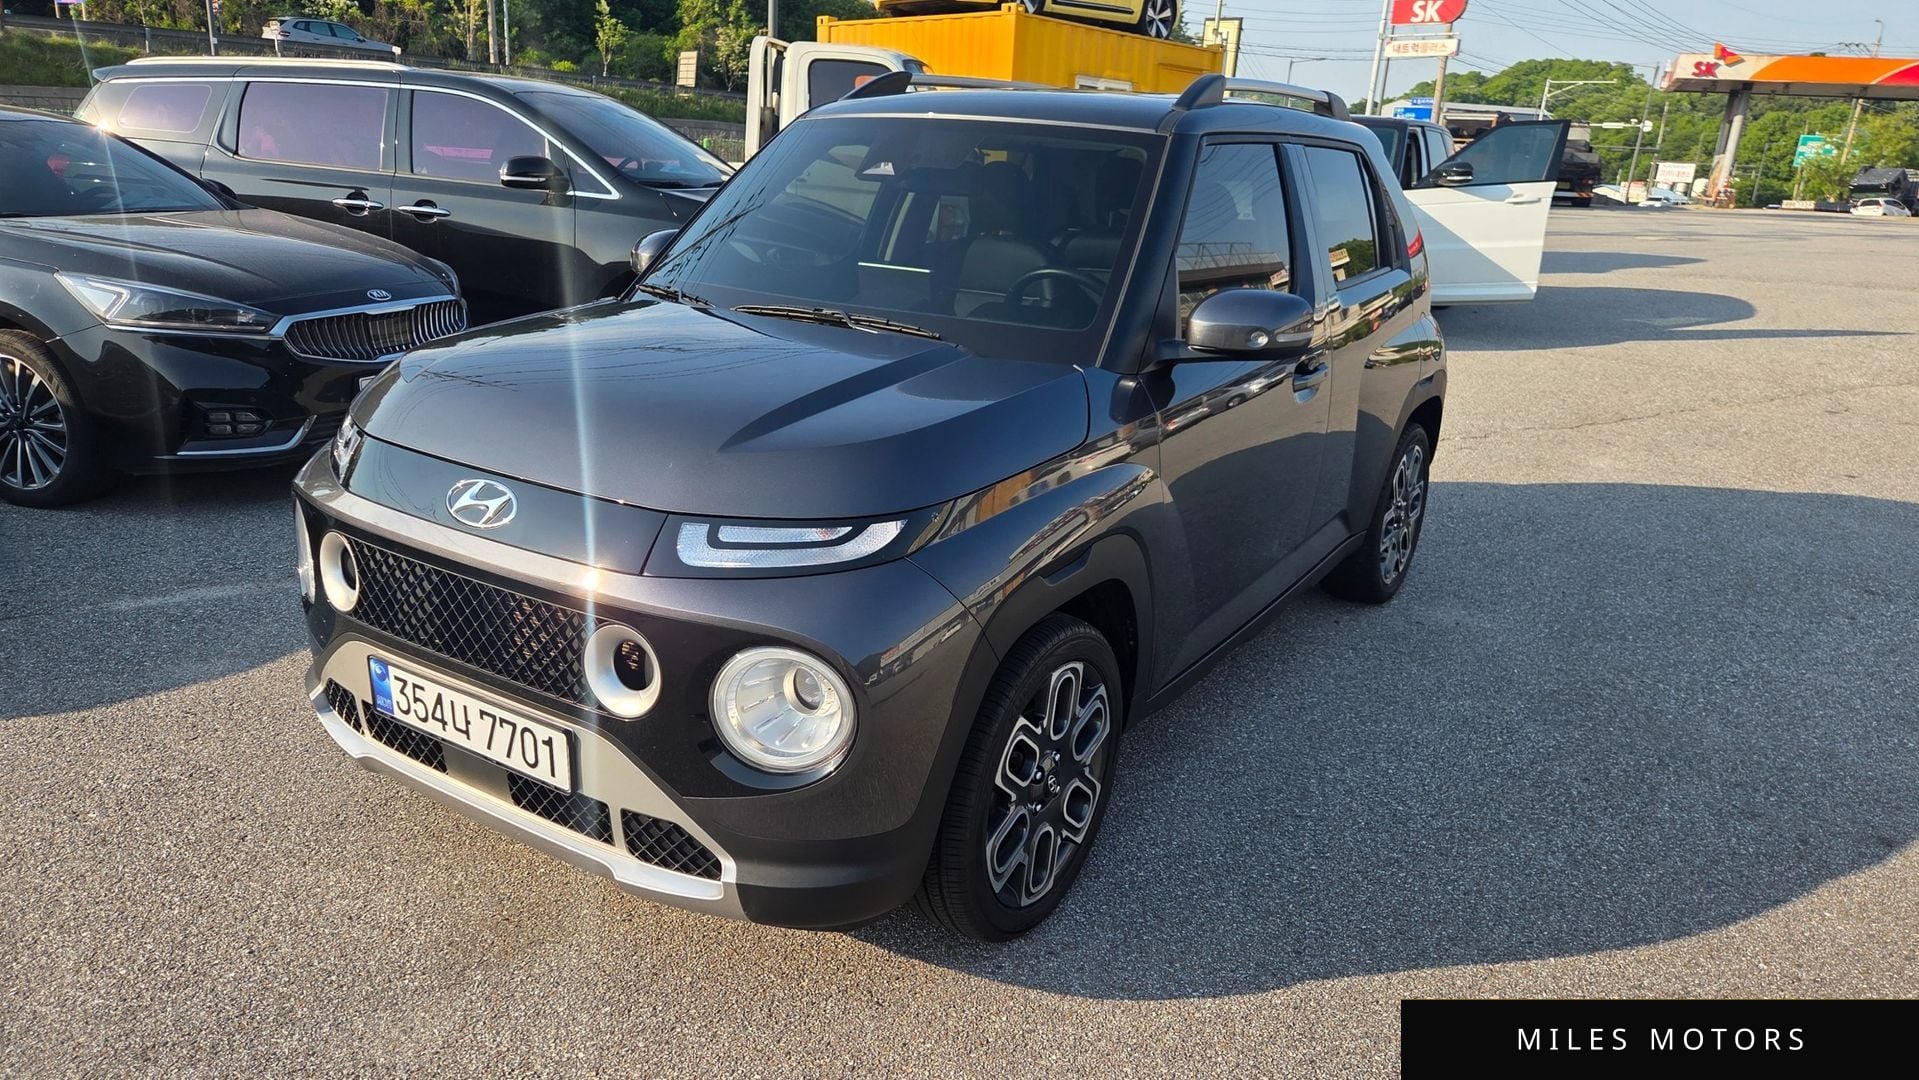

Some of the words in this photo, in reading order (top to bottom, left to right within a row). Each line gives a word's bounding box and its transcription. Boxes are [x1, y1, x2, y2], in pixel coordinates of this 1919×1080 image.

[1410, 0, 1444, 23] SK
[1691, 61, 1722, 78] SK
[393, 674, 471, 741] 354나
[479, 709, 557, 779] 7701
